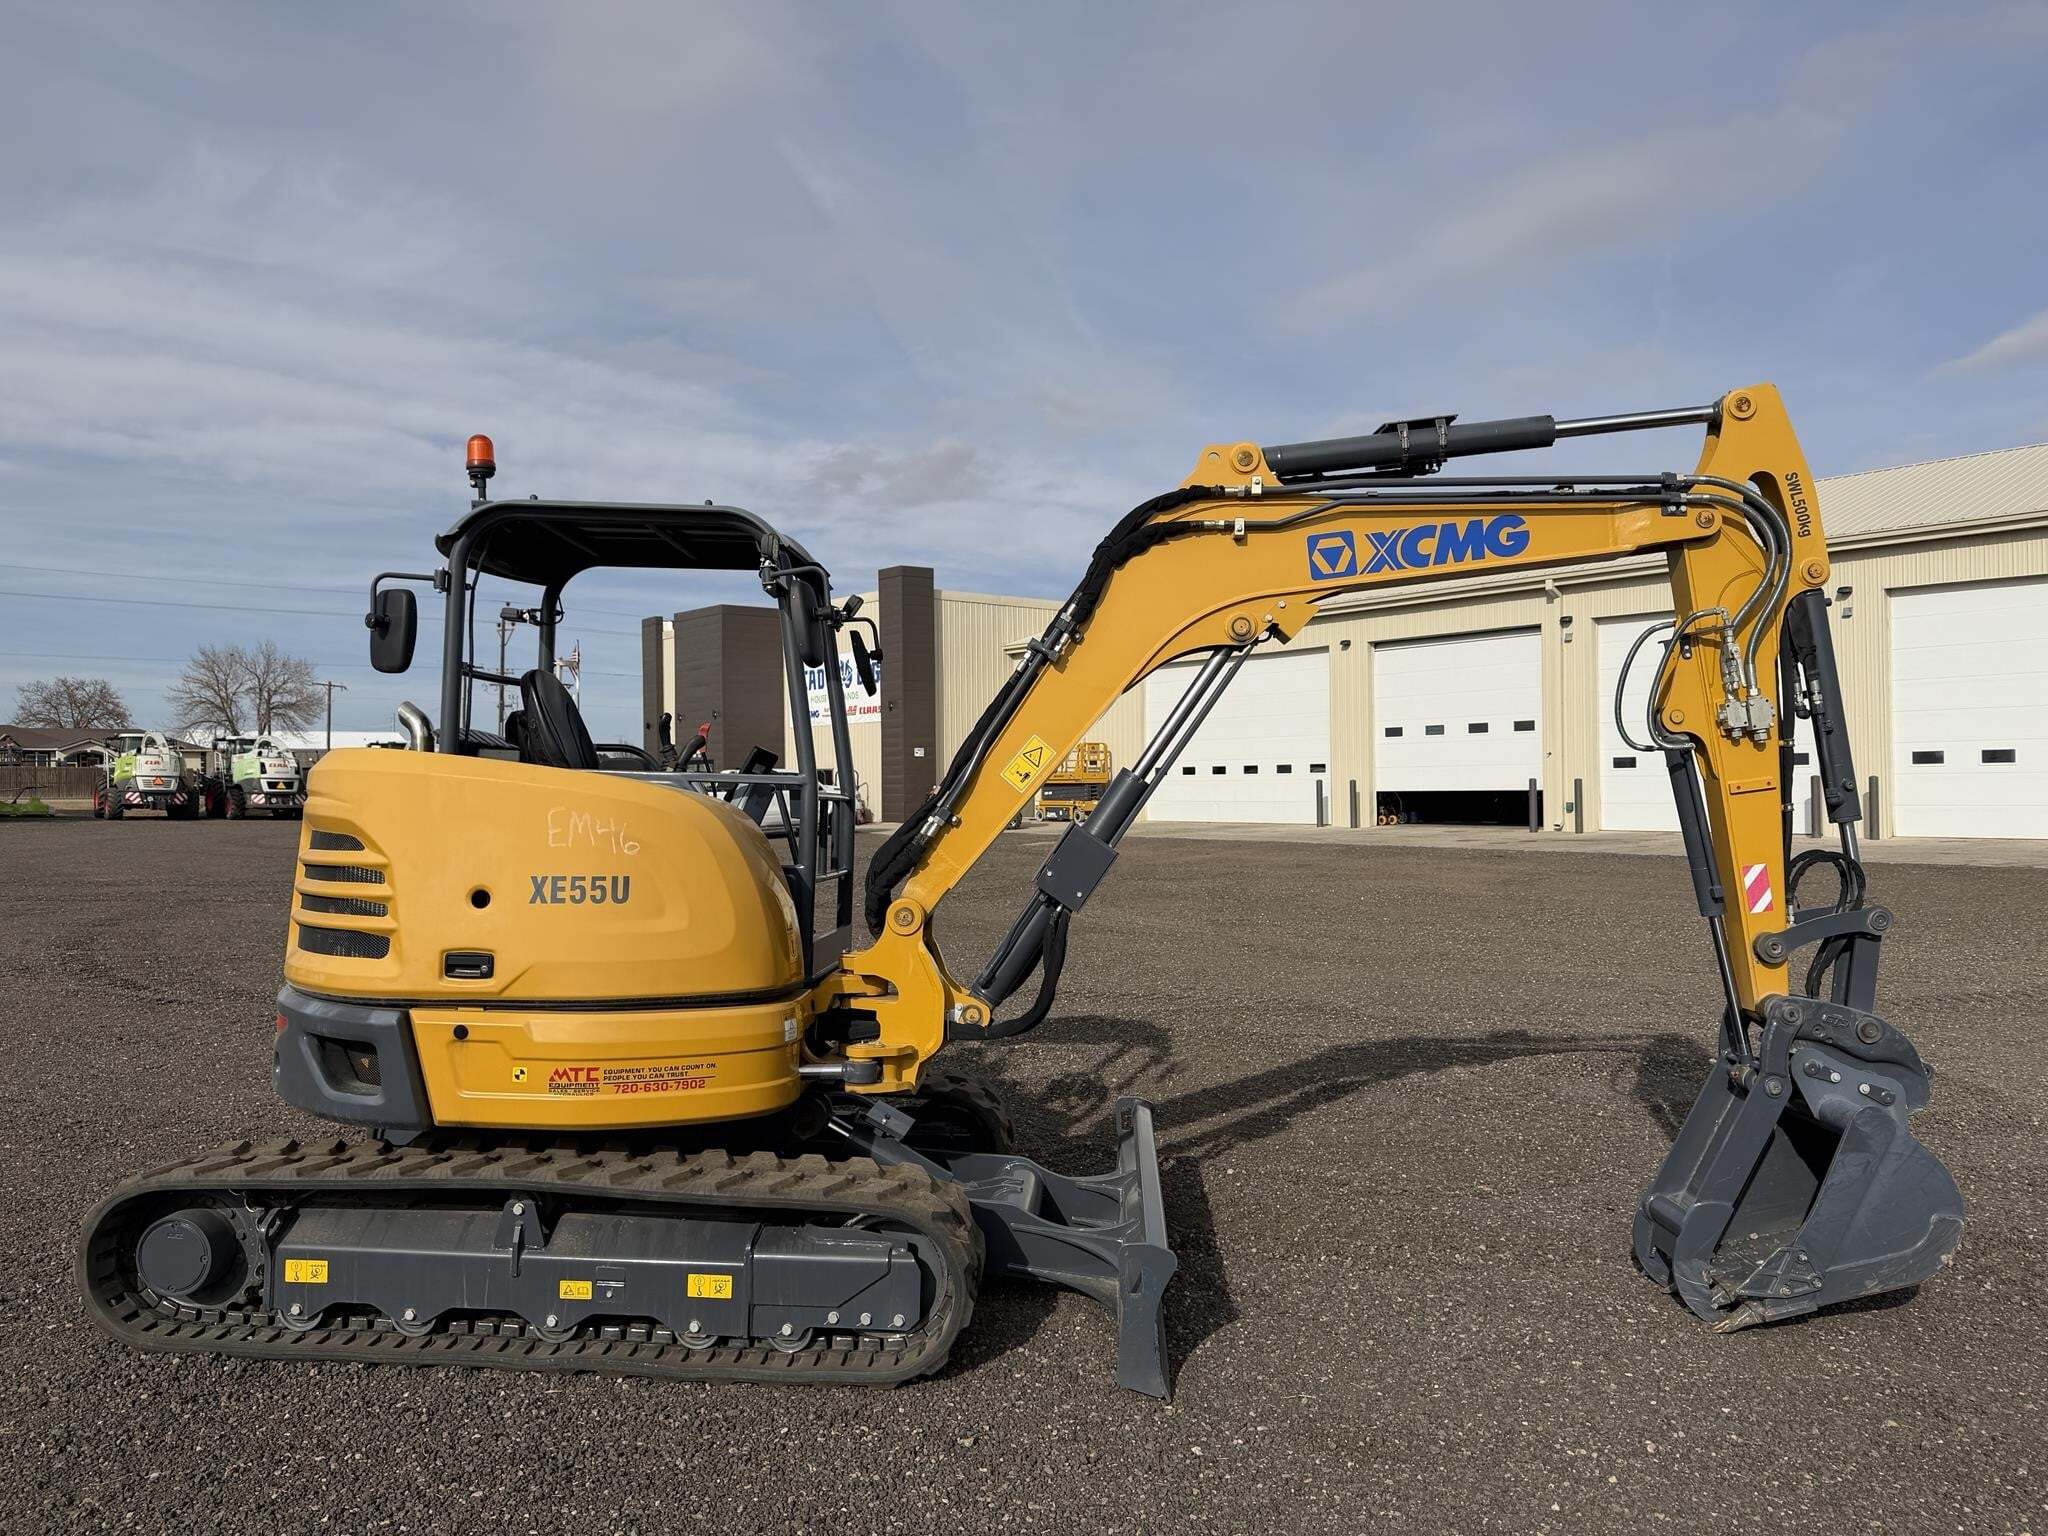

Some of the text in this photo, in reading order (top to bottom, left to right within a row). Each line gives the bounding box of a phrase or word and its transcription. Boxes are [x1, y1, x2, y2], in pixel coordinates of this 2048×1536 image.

[1785, 471, 1812, 537] SWL500kg
[1358, 514, 1531, 575] XCMG
[804, 669, 825, 691] AD
[529, 875, 631, 905] XE55U
[681, 1063, 704, 1071] COUNT
[614, 1079, 705, 1094] 720-630-7902
